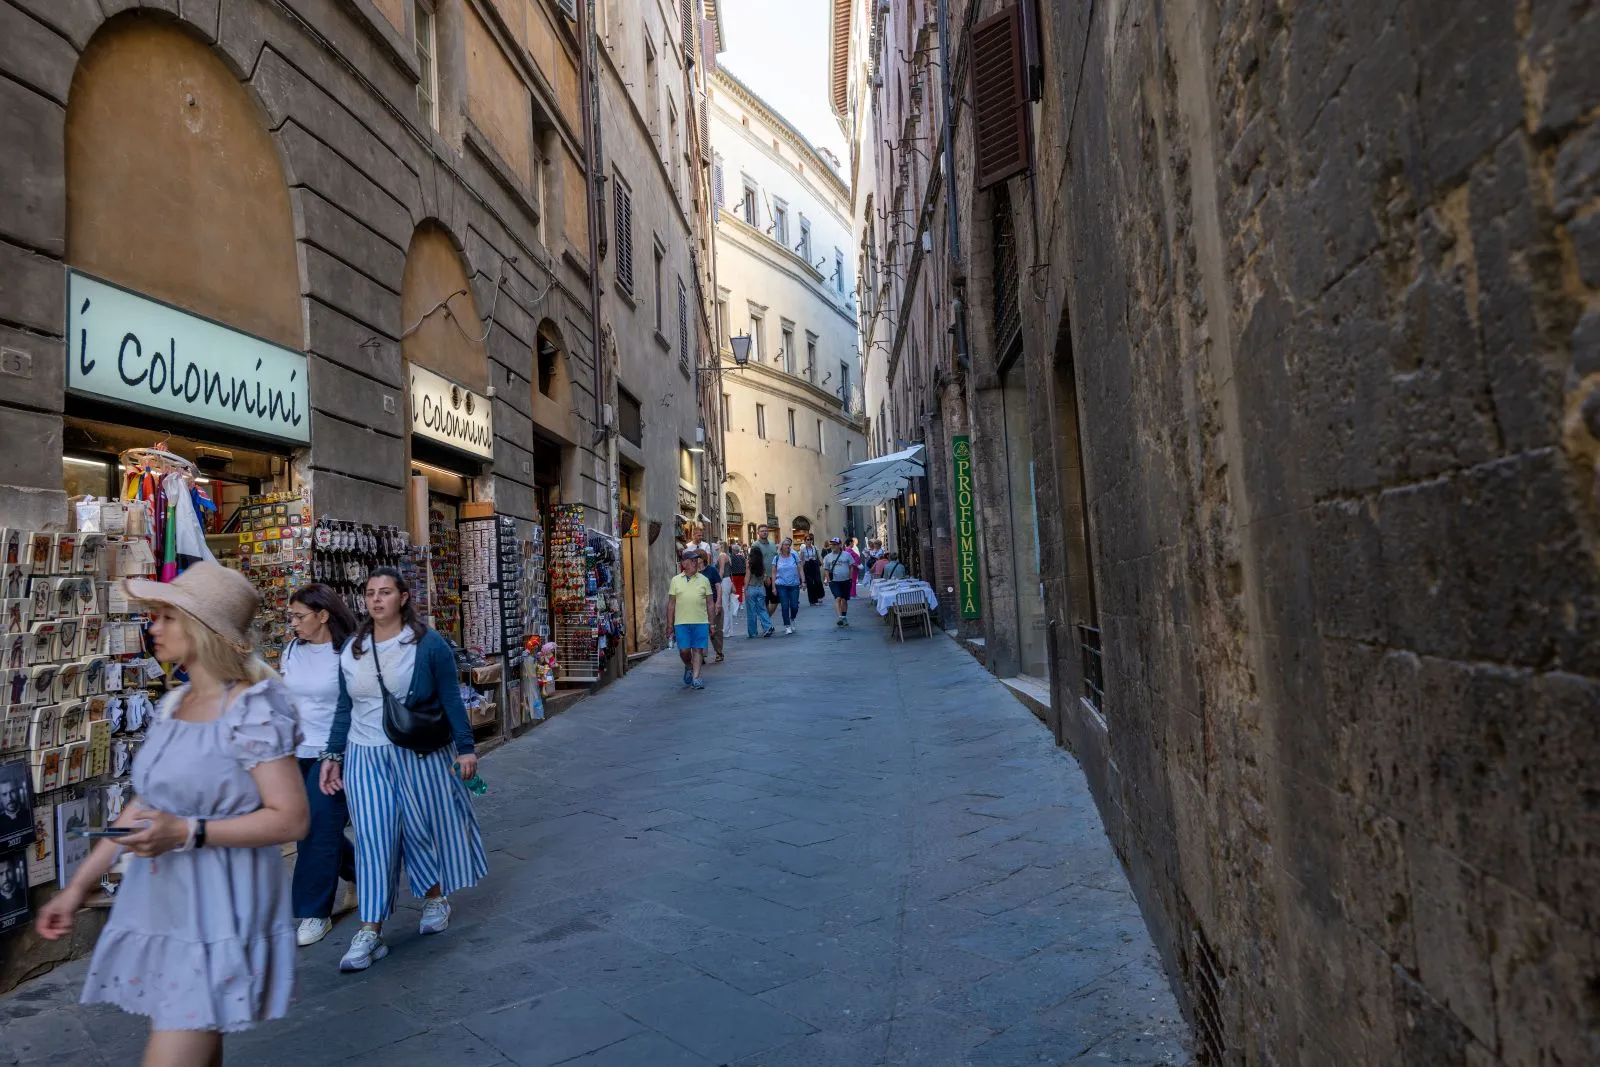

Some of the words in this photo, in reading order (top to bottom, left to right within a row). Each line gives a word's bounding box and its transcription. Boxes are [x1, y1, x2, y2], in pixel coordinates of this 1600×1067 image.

[80, 297, 95, 376] i
[118, 332, 302, 427] Colonnini
[411, 375, 418, 423] i
[422, 394, 492, 449] Colonnini
[957, 461, 976, 613] PROFUMERIA
